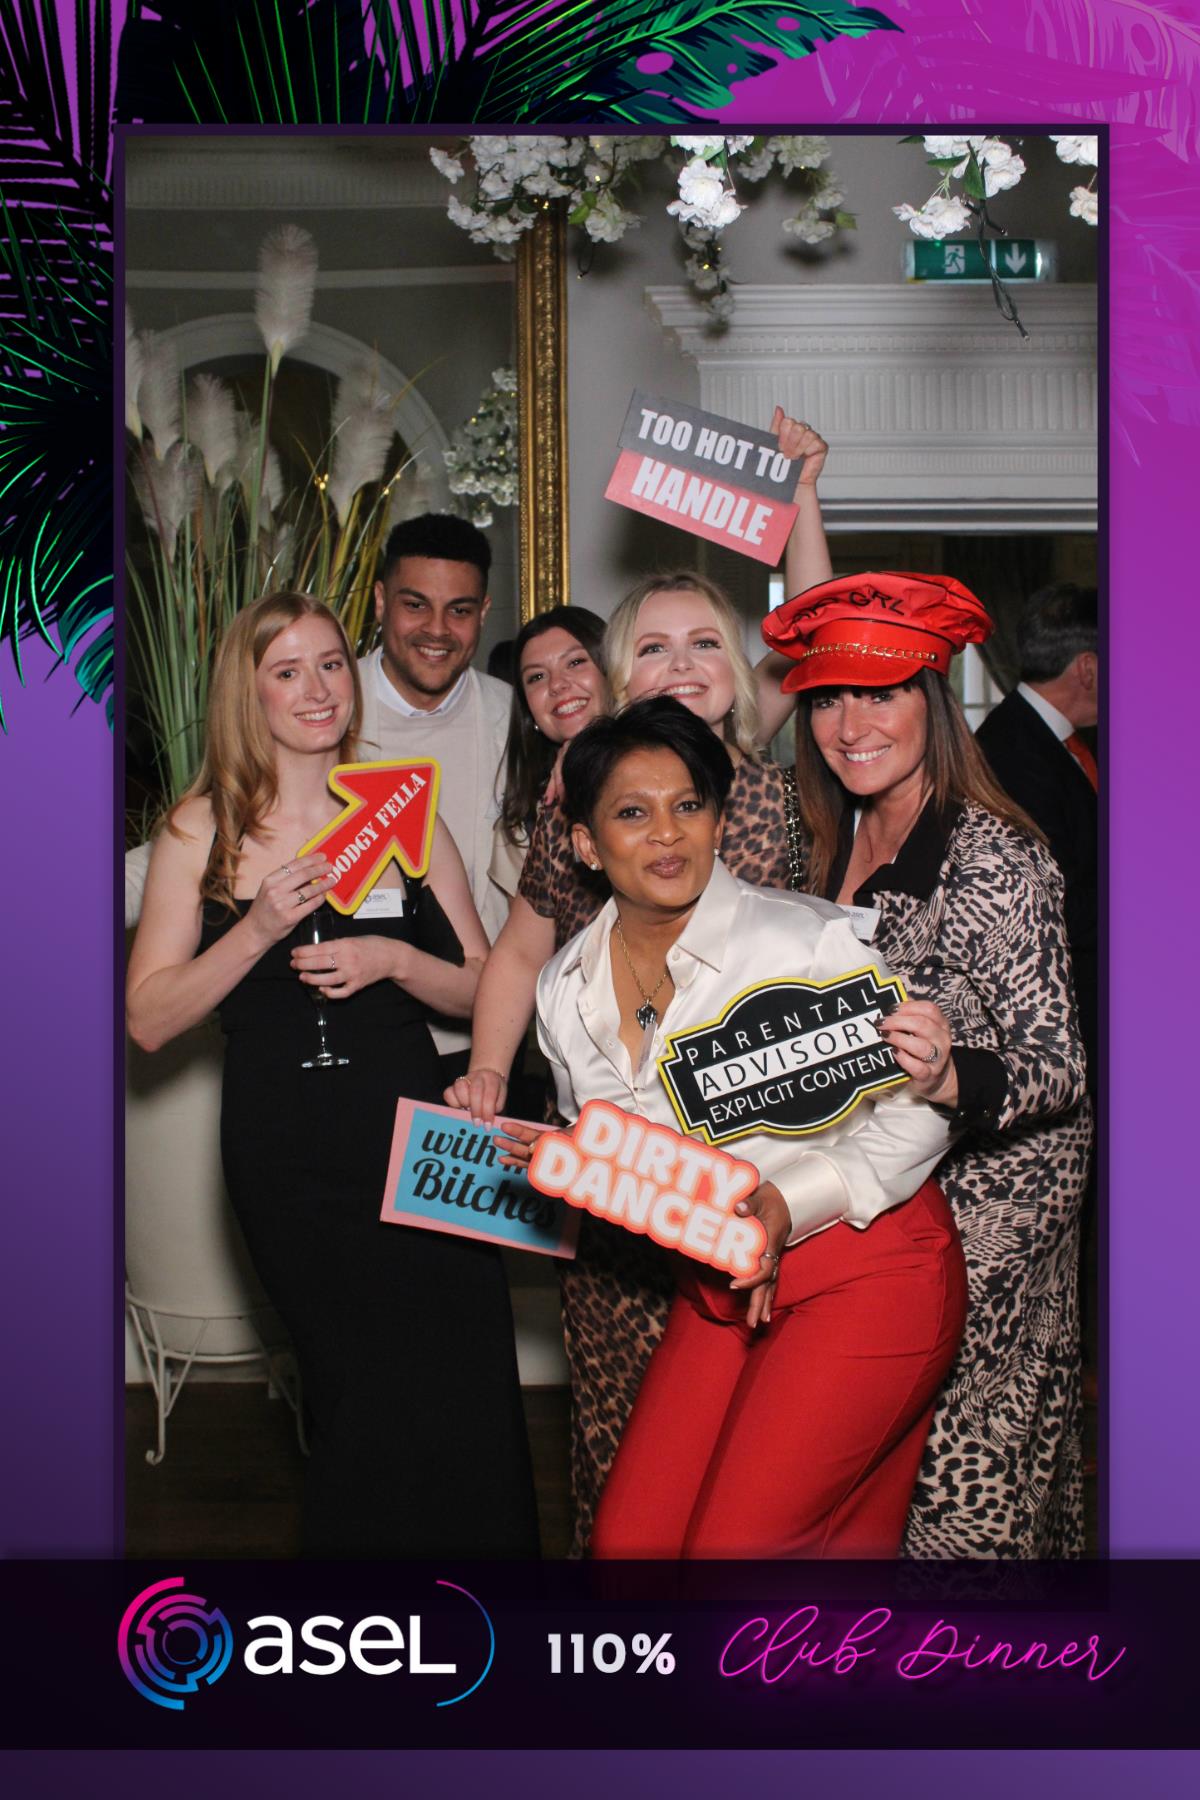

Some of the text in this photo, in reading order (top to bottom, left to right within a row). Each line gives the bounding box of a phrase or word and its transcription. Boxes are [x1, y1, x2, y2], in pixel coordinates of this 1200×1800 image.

[637, 408, 792, 483] TOO HOT TO
[630, 456, 774, 546] HANDLE
[374, 772, 427, 829] FELLA
[685, 988, 877, 1066] PARENTAL
[701, 1012, 882, 1097] ADVISORY
[710, 1046, 896, 1124] EXPLICIT CONTENT
[421, 1127, 497, 1168] with
[579, 1109, 749, 1210] DIRTY
[412, 1157, 557, 1228] Bitches
[534, 1141, 757, 1269] DANCER
